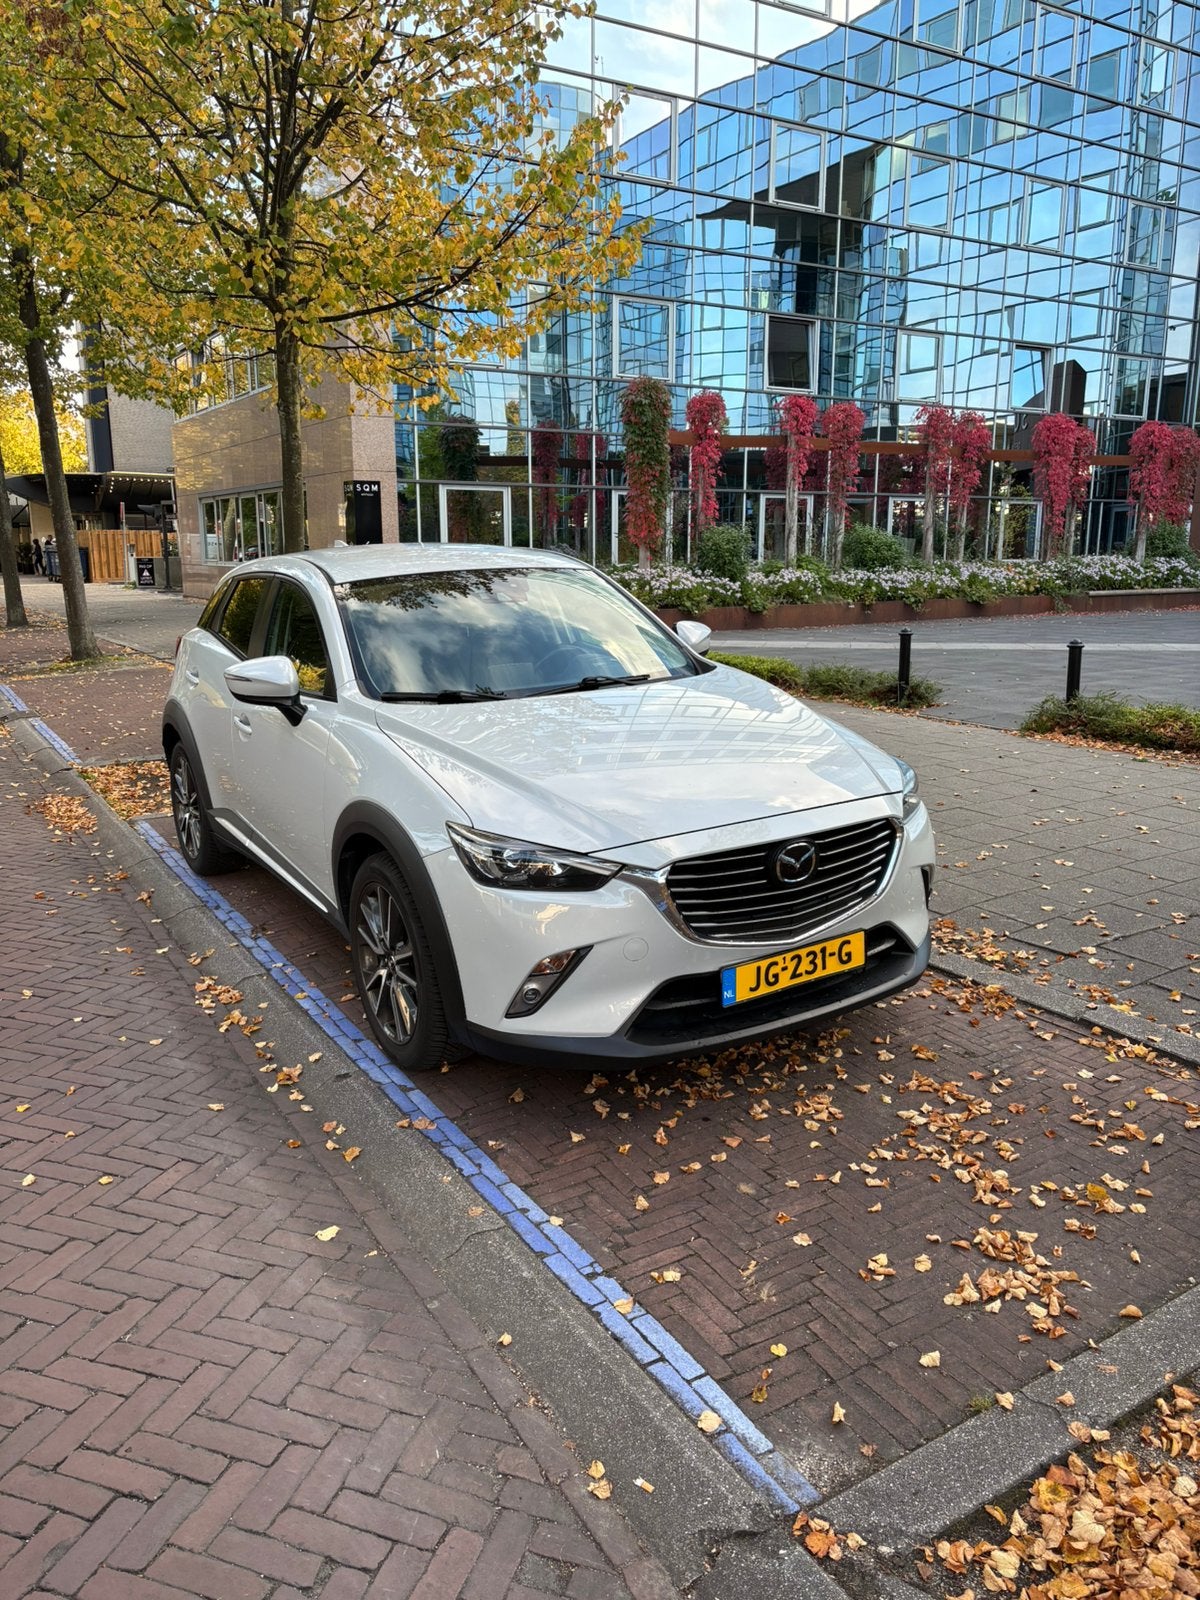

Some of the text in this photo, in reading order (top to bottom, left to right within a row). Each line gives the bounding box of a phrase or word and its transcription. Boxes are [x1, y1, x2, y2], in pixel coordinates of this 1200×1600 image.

[356, 483, 378, 492] SQM
[749, 939, 852, 993] JG-231-G
[723, 990, 735, 999] NL
